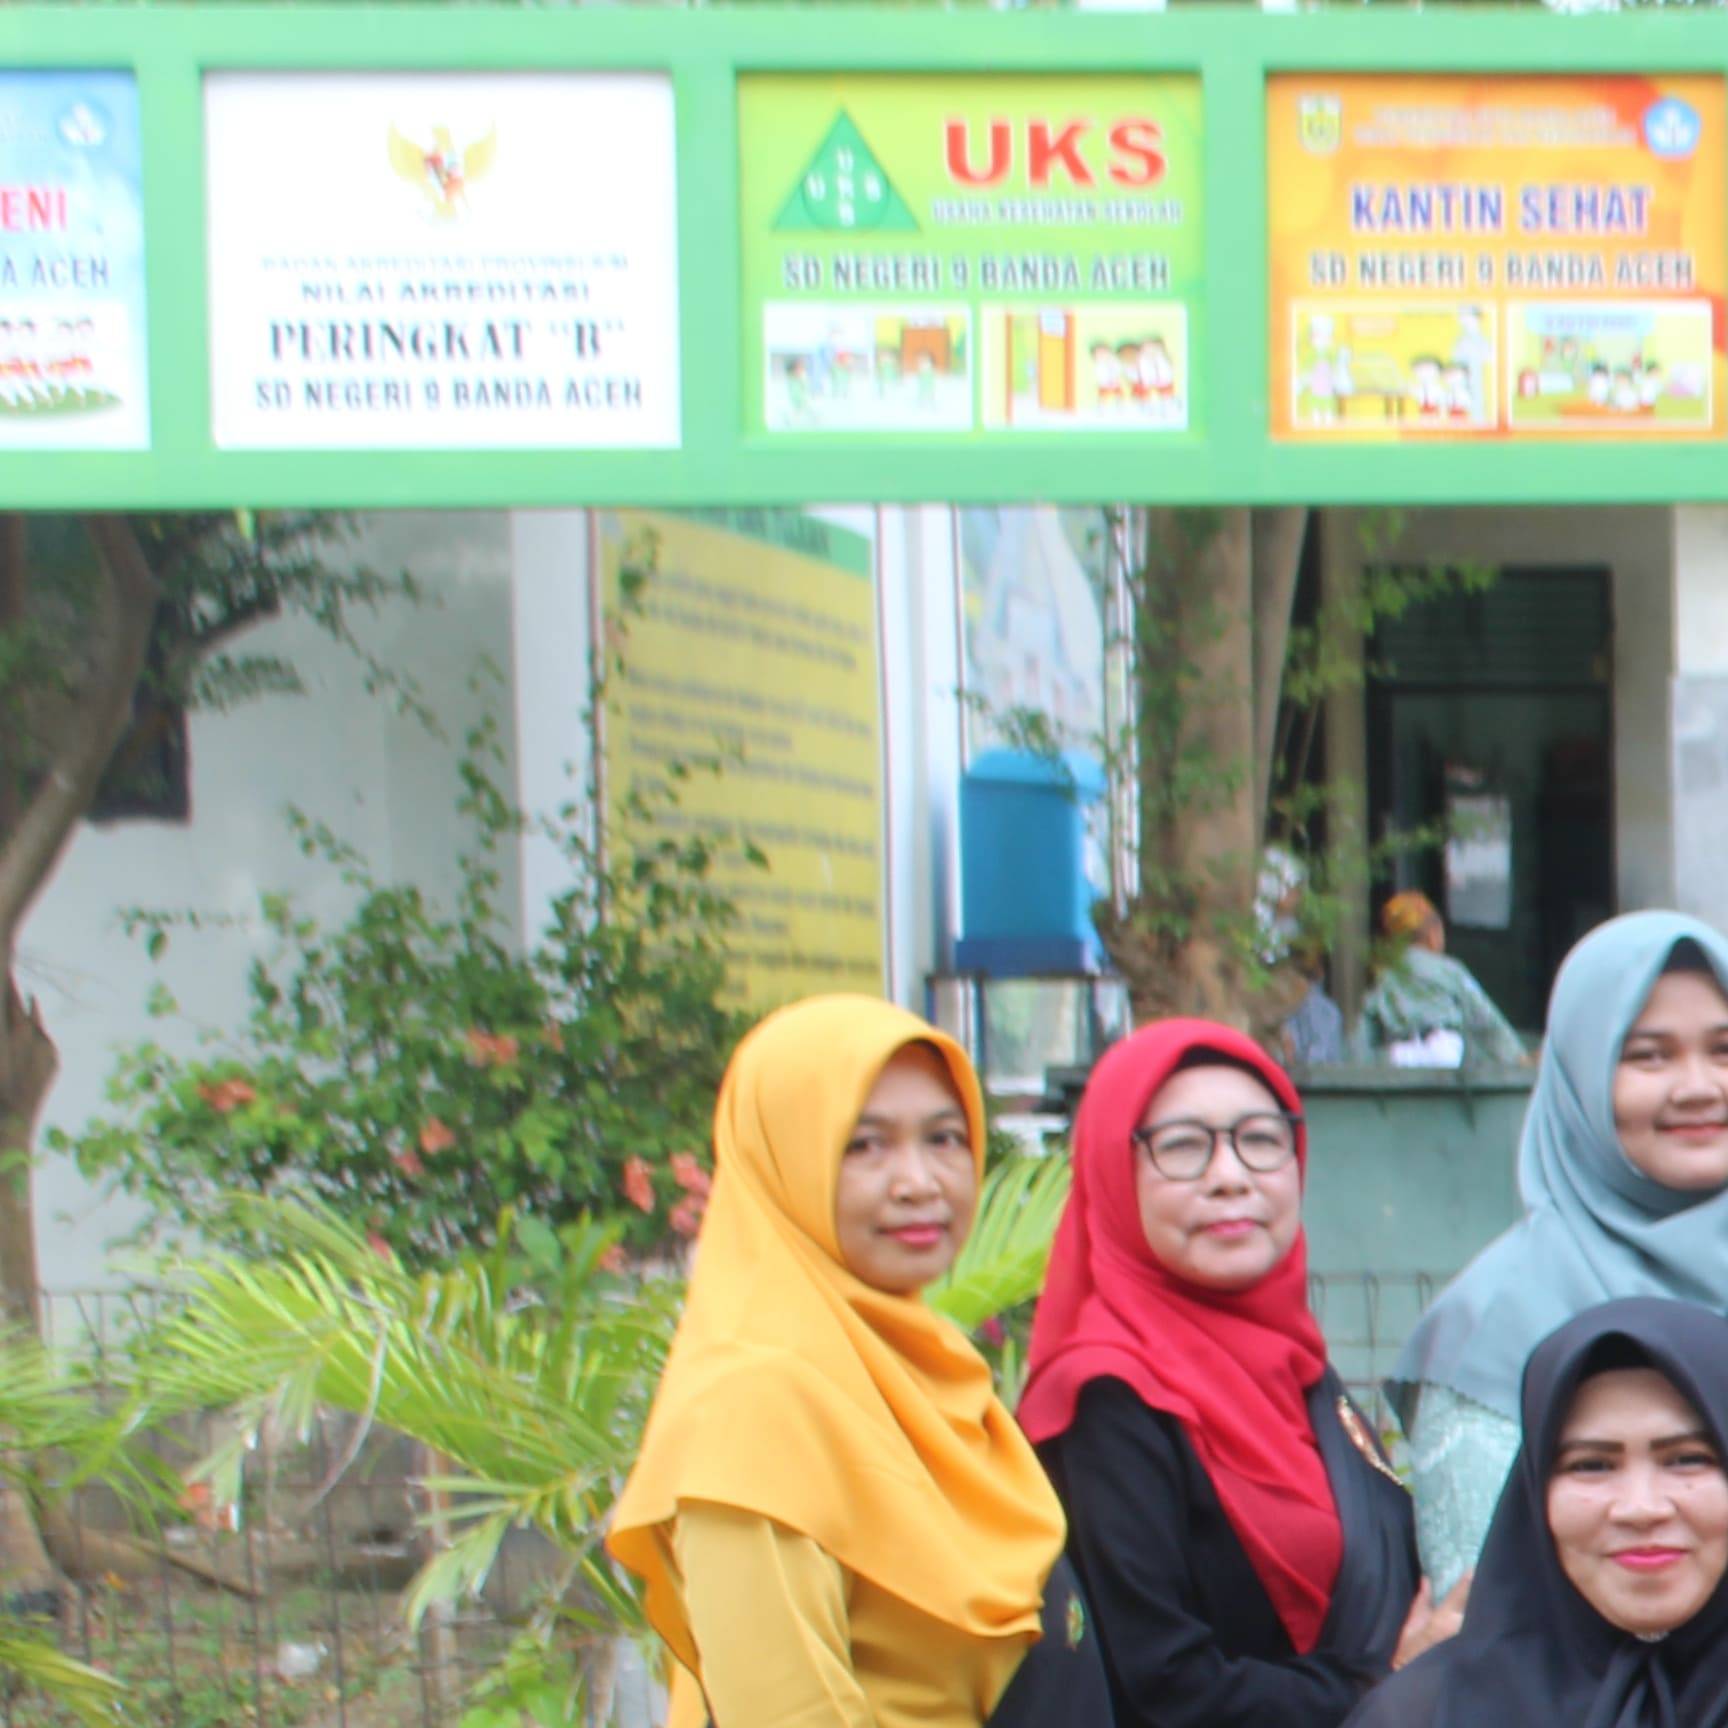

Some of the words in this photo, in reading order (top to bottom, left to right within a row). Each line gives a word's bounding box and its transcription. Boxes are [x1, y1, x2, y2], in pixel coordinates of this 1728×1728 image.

[945, 117, 1167, 188] UKS
[1351, 182, 1503, 234] KANTIN
[1520, 184, 1653, 235] SEHAT
[31, 253, 109, 289] ACEH
[784, 255, 823, 290] SD
[833, 255, 942, 290] NEGERI
[952, 255, 969, 290] 9
[981, 255, 1081, 290] BANDA
[1092, 255, 1171, 290] ACEH
[1311, 252, 1348, 288] SD
[1360, 252, 1464, 288] NEGERI
[1478, 252, 1494, 288] 9
[1506, 252, 1604, 288] BANDA
[1616, 252, 1694, 288] ACEH
[271, 319, 532, 362] PERINGKAT
[256, 377, 293, 411] SD
[305, 377, 412, 411] NEGERI
[425, 377, 441, 411] 9
[453, 377, 551, 411] BANDA
[565, 377, 643, 411] ACEH
